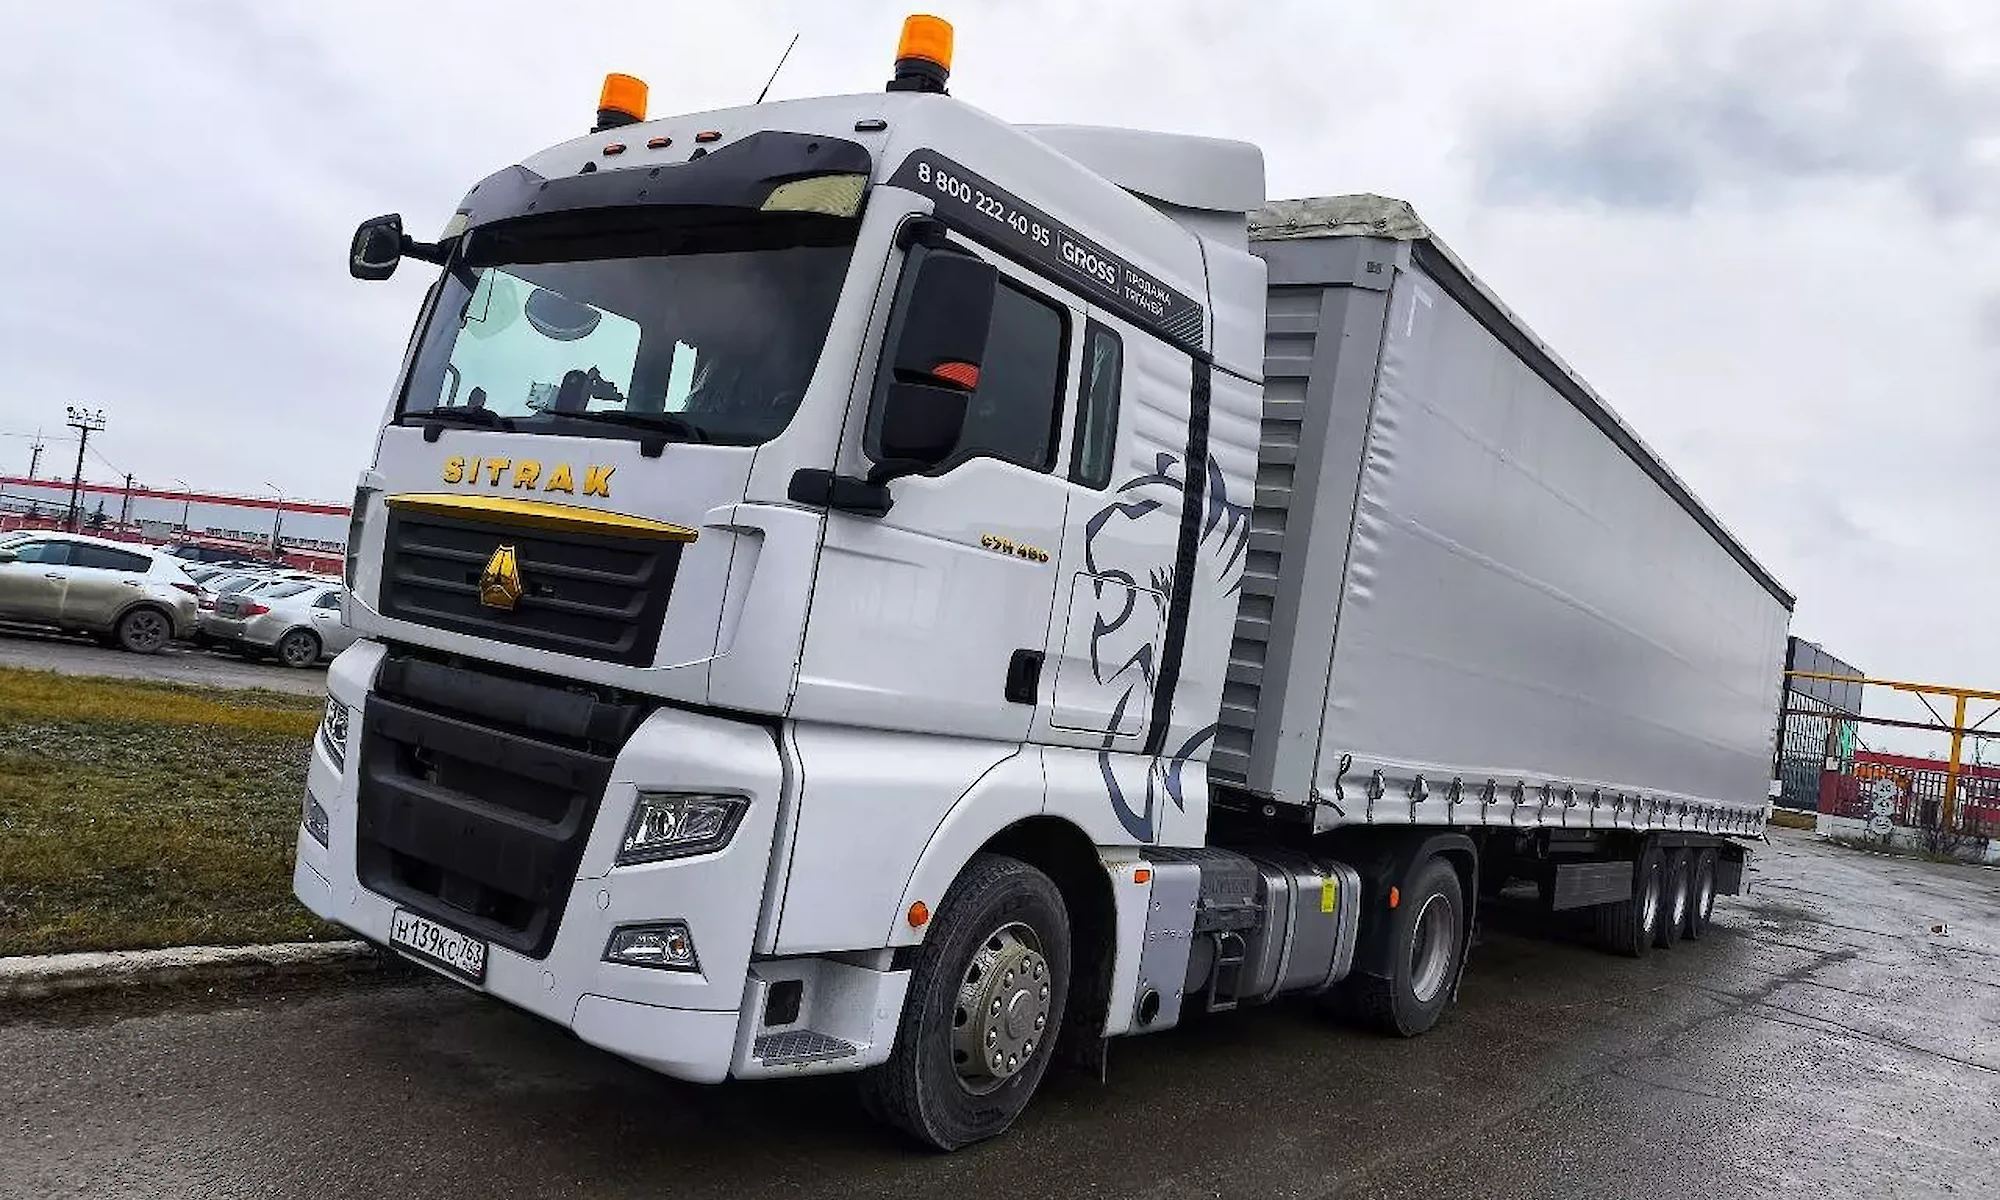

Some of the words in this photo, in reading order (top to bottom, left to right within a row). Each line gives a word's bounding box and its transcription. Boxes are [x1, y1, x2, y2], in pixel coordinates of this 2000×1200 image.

[917, 162, 932, 183] 8
[935, 170, 972, 203] 800
[975, 190, 1004, 222] 222
[1007, 210, 1028, 234] 40
[1031, 223, 1050, 247] 95
[1062, 240, 1116, 285] GROSS
[1124, 286, 1164, 317] ТЯГАЧЕЙ
[1125, 269, 1172, 306] ПРОДАЖА
[443, 456, 616, 498] SITRAK
[459, 936, 482, 964] 763
